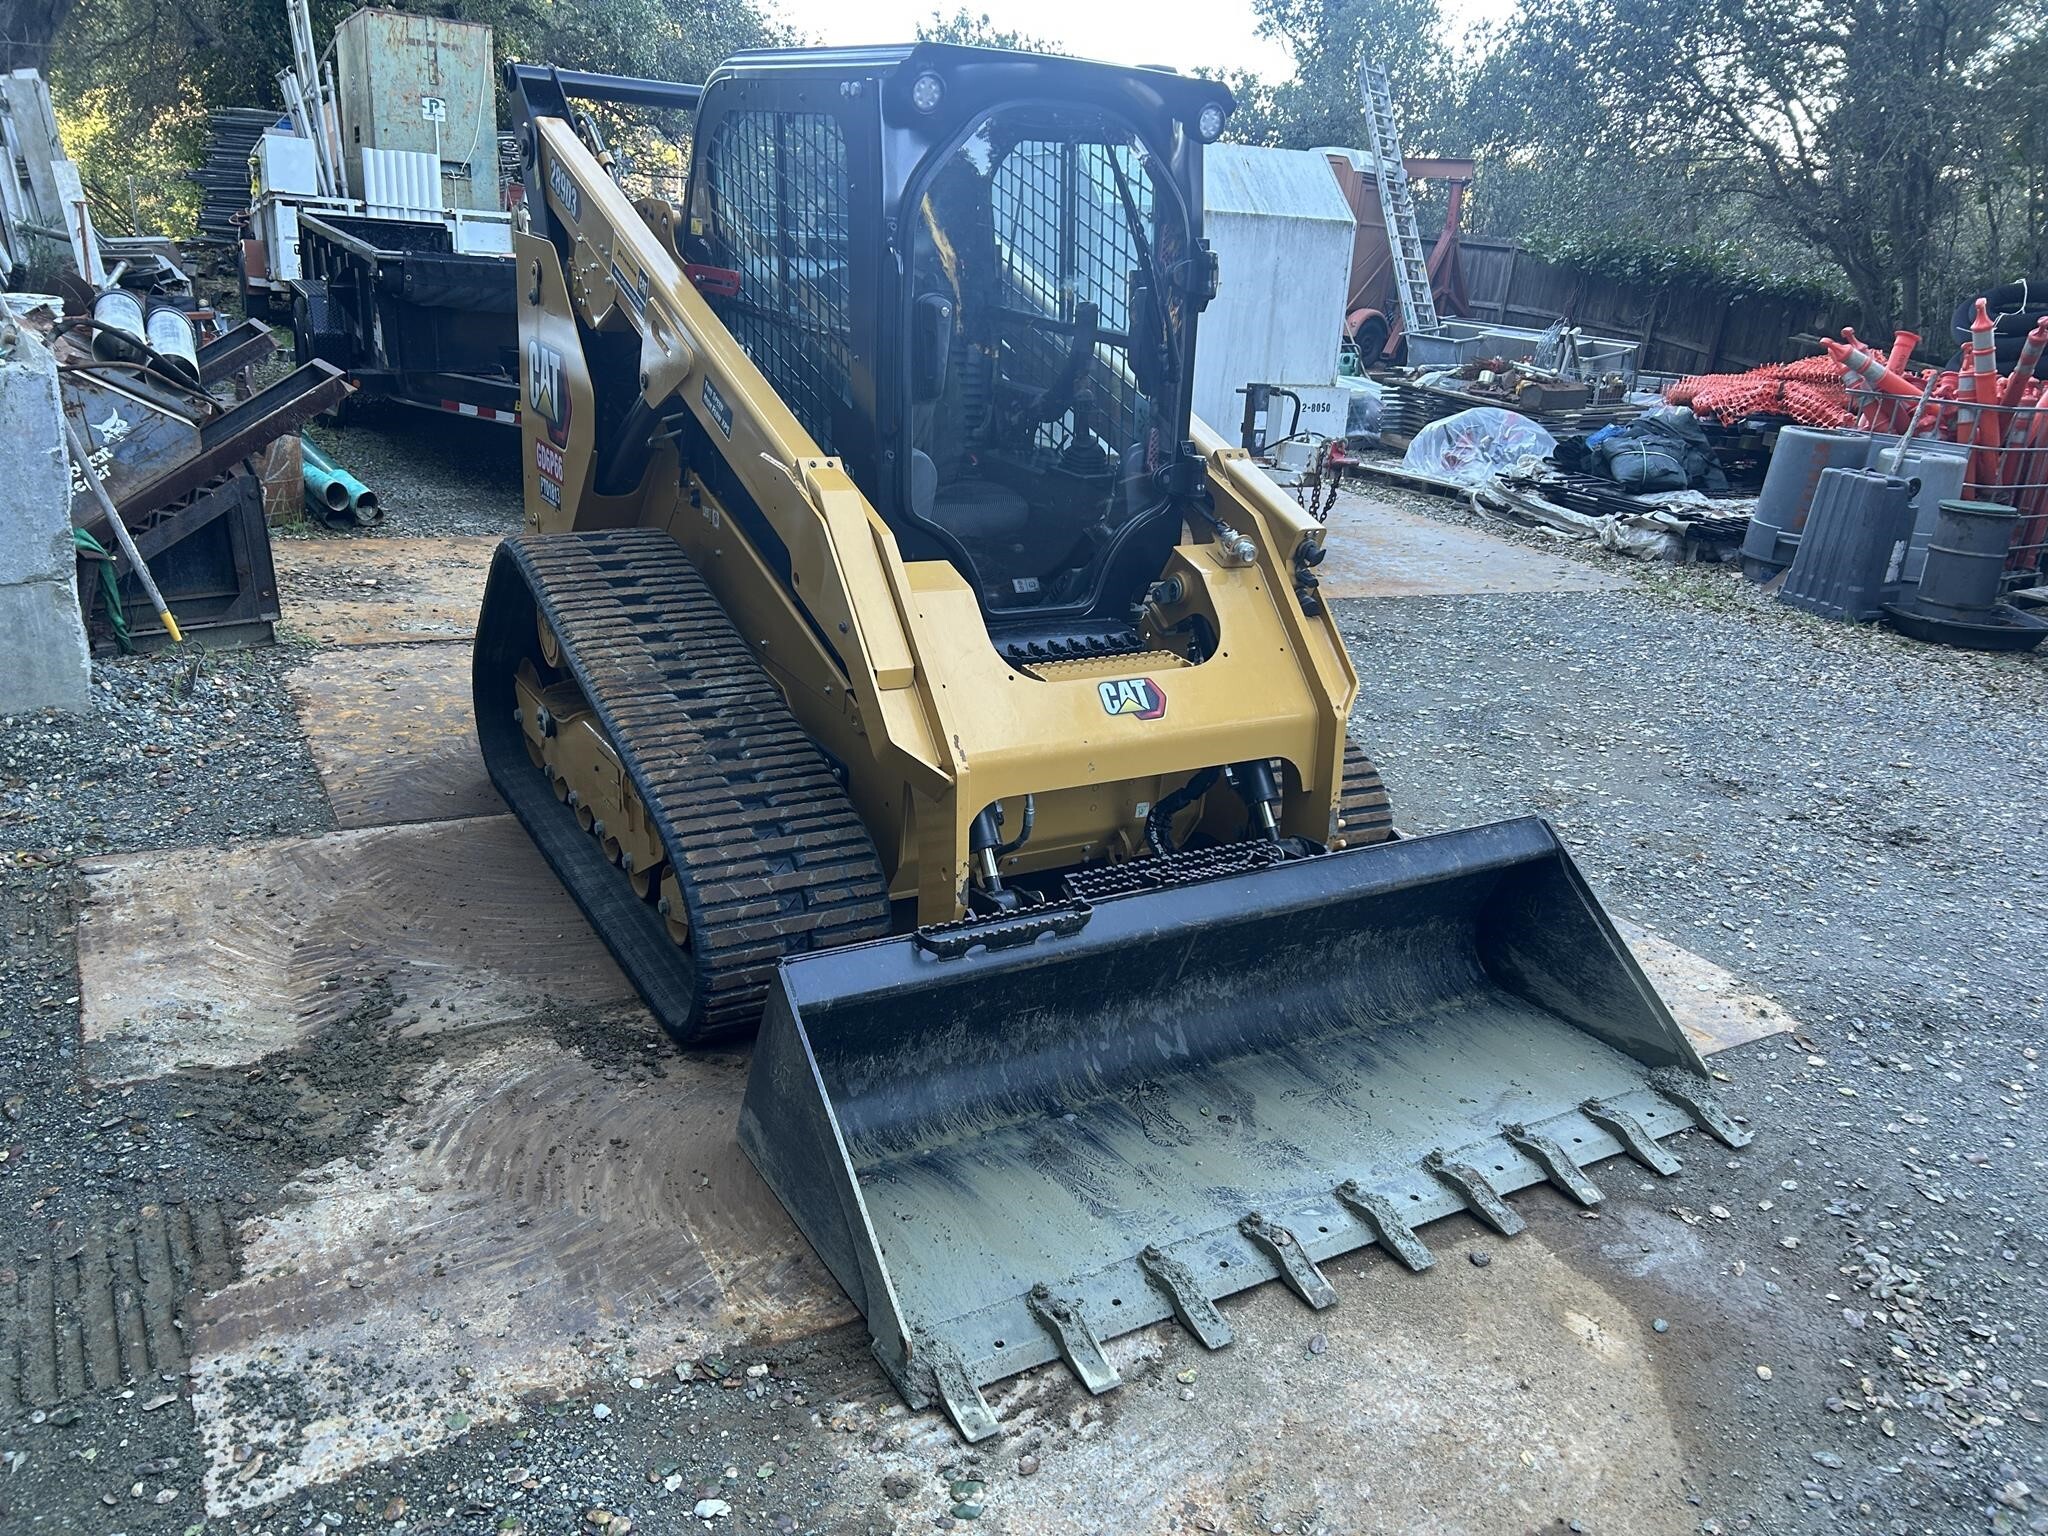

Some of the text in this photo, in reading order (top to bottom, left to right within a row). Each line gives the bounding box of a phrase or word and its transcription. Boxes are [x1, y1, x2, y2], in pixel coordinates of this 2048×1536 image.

[550, 157, 577, 218] 289D3
[528, 340, 561, 423] CAT
[1301, 402, 1331, 413] 2-8050
[1099, 679, 1150, 715] CAT
